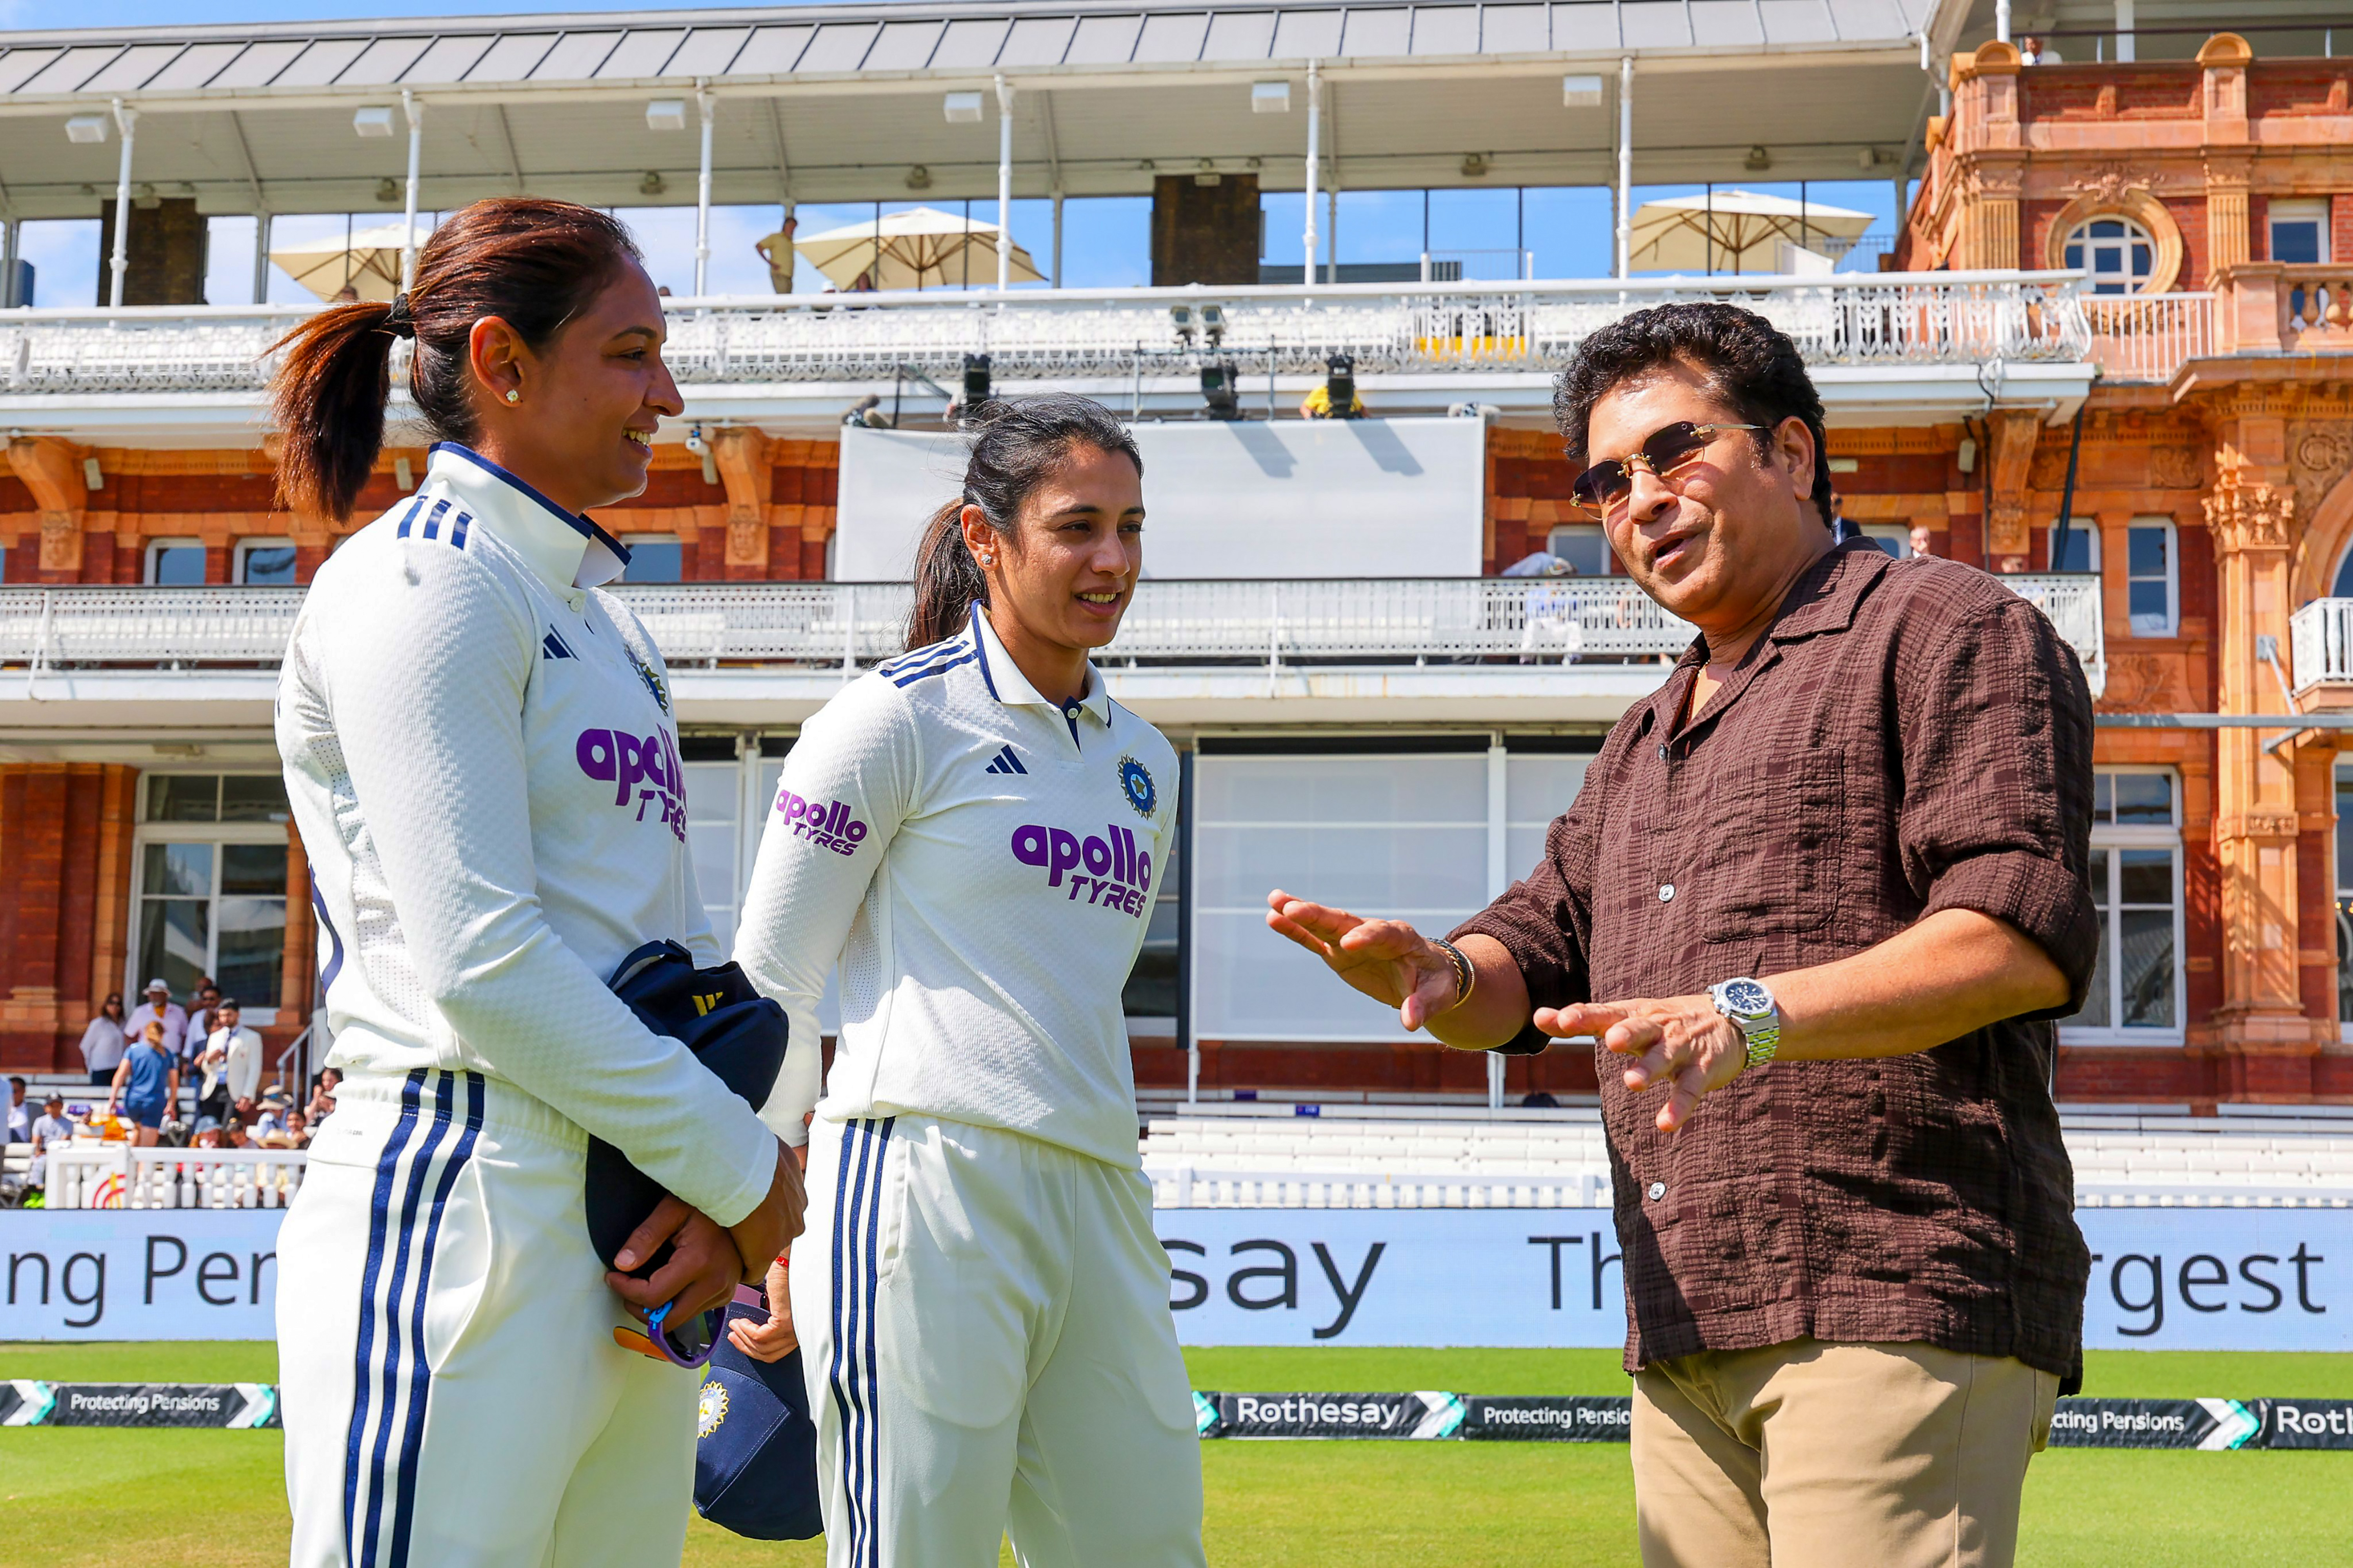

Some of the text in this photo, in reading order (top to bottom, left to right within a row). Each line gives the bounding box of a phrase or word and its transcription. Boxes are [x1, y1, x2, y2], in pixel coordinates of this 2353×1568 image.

[576, 723, 687, 814] apoll
[776, 789, 867, 842] apollo
[793, 822, 858, 856] TYRES
[1011, 823, 1151, 892] apollo
[1068, 874, 1147, 919] TYRES
[8, 1252, 105, 1328] ng
[1160, 1239, 1387, 1339] say
[2091, 1242, 2326, 1337] gest
[71, 1393, 220, 1414] Protecting Pensions
[1237, 1397, 1400, 1430] Rothesay
[1484, 1406, 1572, 1428] Protecting
[2050, 1410, 2185, 1434] cting Pensions
